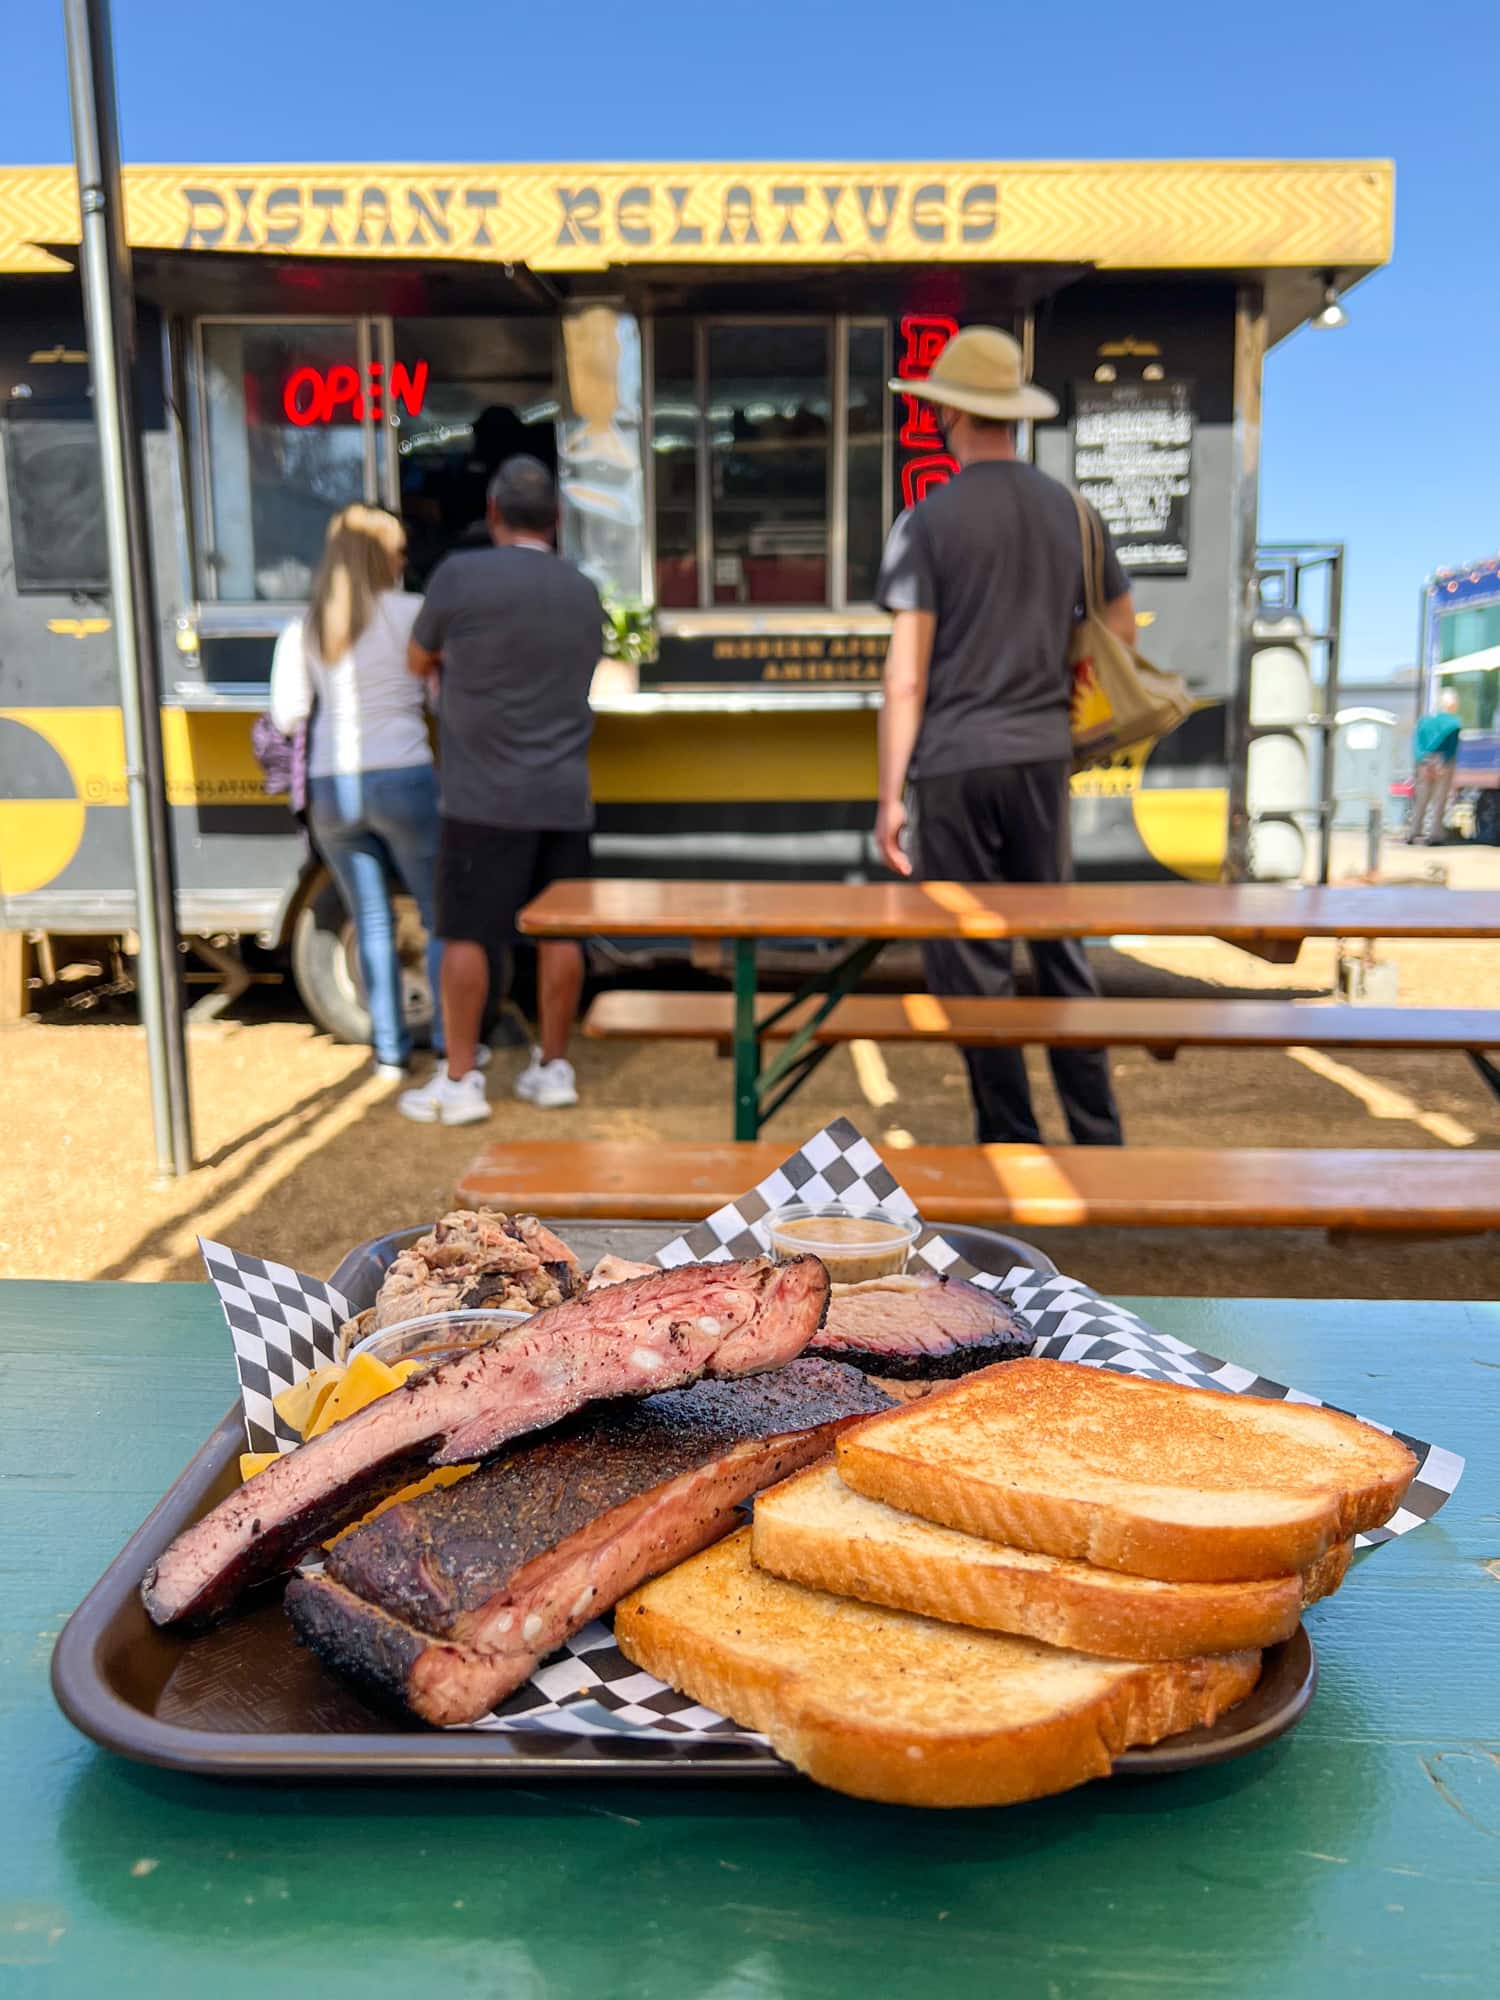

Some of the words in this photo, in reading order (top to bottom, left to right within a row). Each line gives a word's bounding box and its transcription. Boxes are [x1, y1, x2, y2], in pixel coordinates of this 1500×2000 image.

[180, 186, 500, 248] DISTANT
[555, 183, 998, 245] RELATIVES
[283, 360, 429, 427] OPEN
[763, 661, 882, 680] AMERICA
